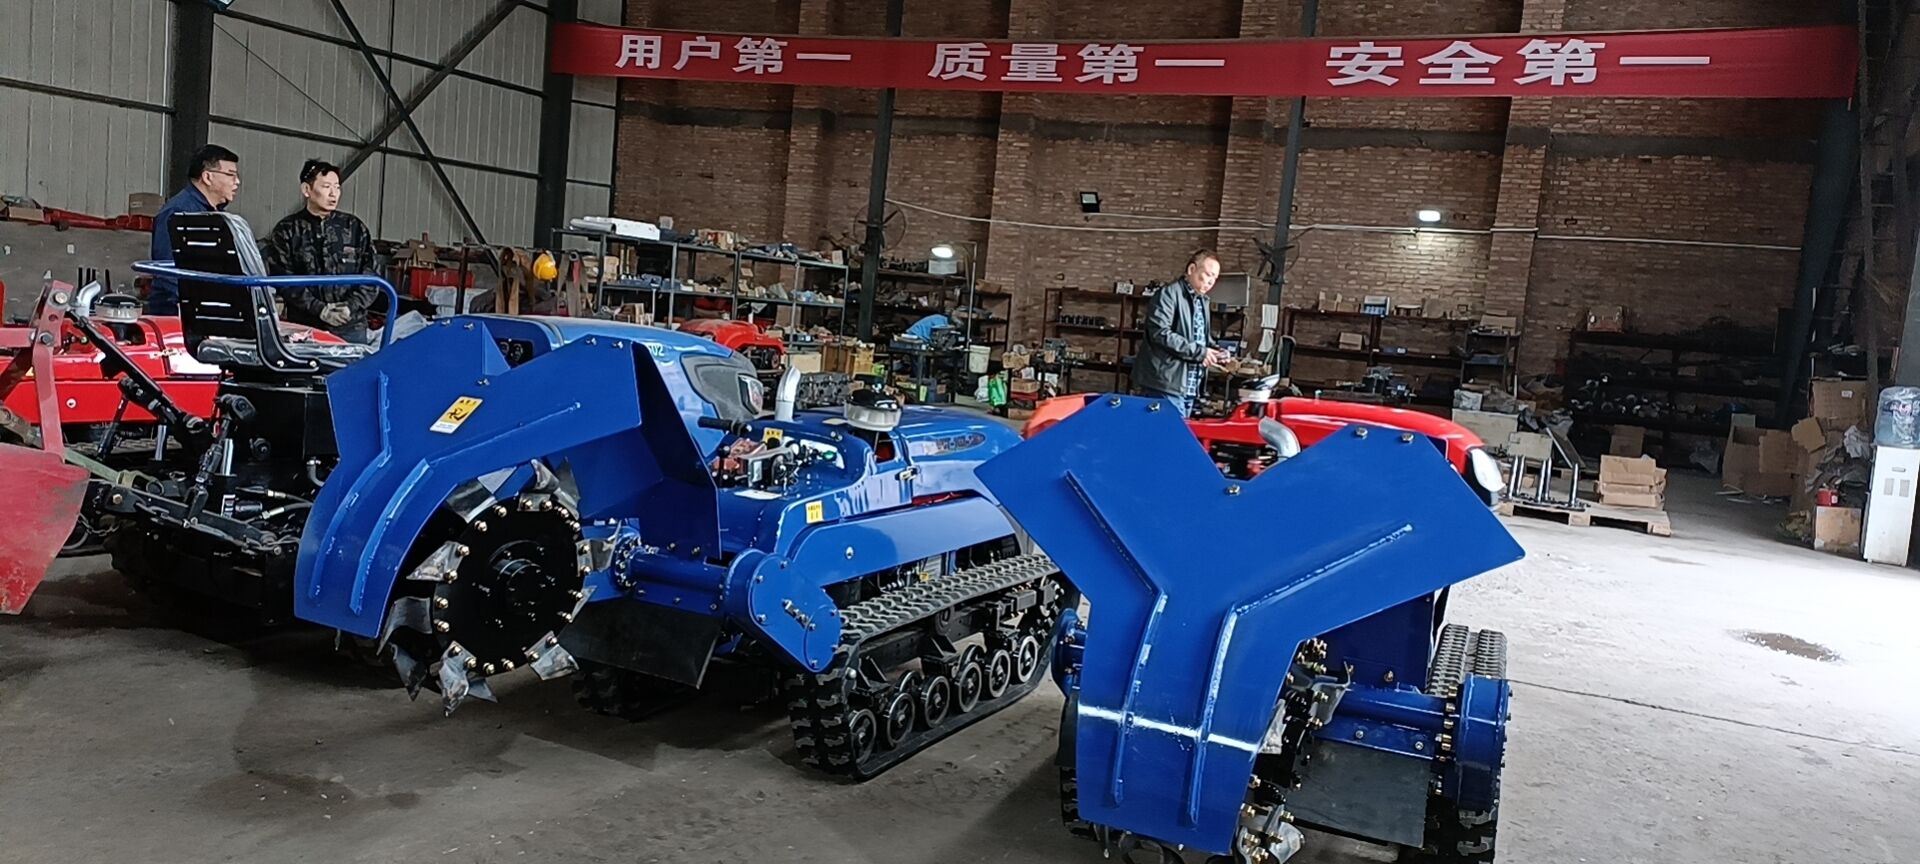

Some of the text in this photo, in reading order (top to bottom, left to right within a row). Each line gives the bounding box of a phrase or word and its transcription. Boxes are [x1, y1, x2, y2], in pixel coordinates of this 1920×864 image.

[615, 34, 1710, 86] 用户第一 质量第一 安全第一
